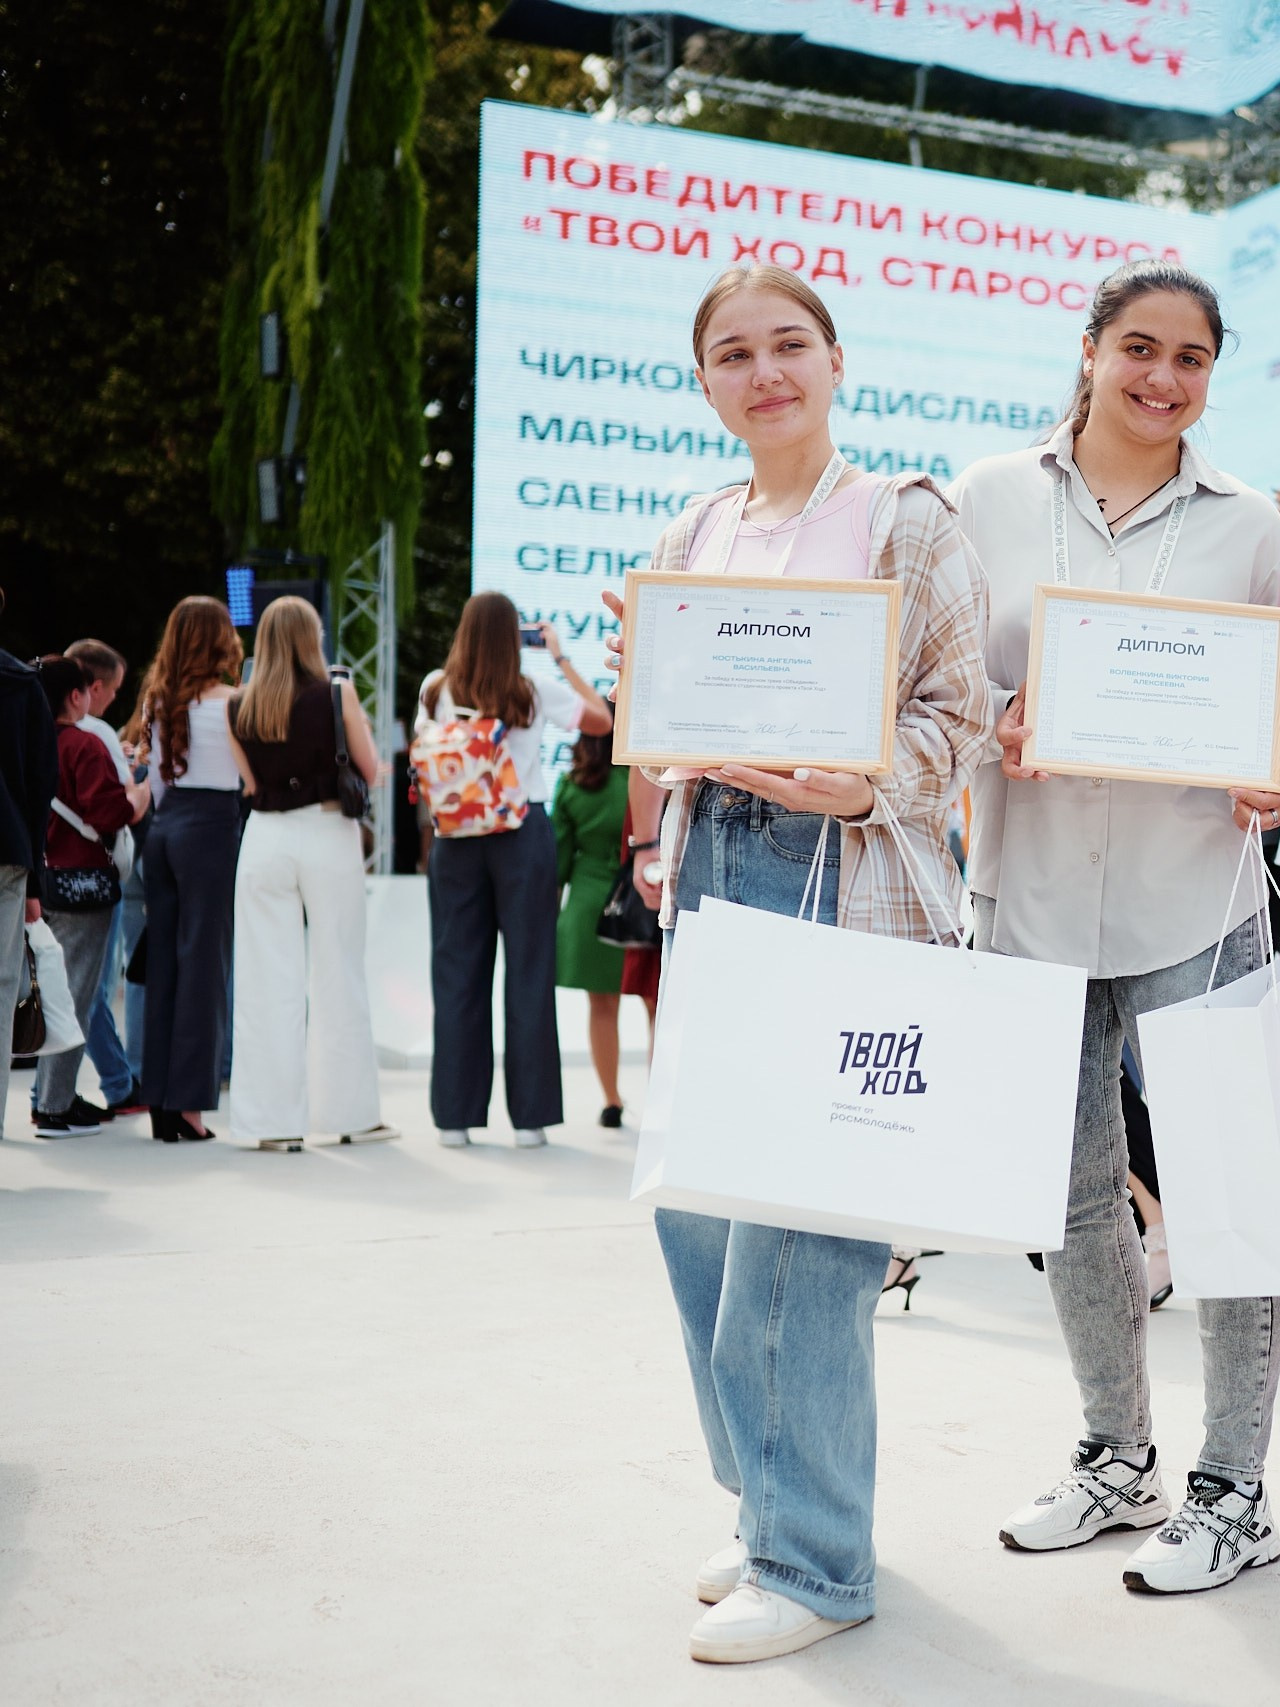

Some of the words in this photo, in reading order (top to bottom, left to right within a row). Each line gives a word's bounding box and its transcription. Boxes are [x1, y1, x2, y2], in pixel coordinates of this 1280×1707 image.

[522, 149, 902, 235] ПОБЕДИТЕЛИ
[1150, 543, 1173, 590] РОССИИ
[718, 622, 811, 638] ДИПЛОМ
[1117, 638, 1205, 656] ДИПЛОМ
[712, 655, 765, 663] КОСТЬКИНА
[767, 657, 812, 665] АНГЕЛИНА
[732, 664, 790, 672] ВАСИЛЬЕВНА
[1109, 668, 1164, 679] ВОЛВЕНКИНА
[1166, 673, 1210, 682] ВИКТОРИЯ
[1133, 678, 1186, 688] АЛЕКСЕЕВНА
[839, 1025, 923, 1074] ТВОЙ
[860, 1070, 928, 1095] ХОД
[832, 1102, 862, 1112] проект
[830, 1112, 915, 1134] росмолодёжь
